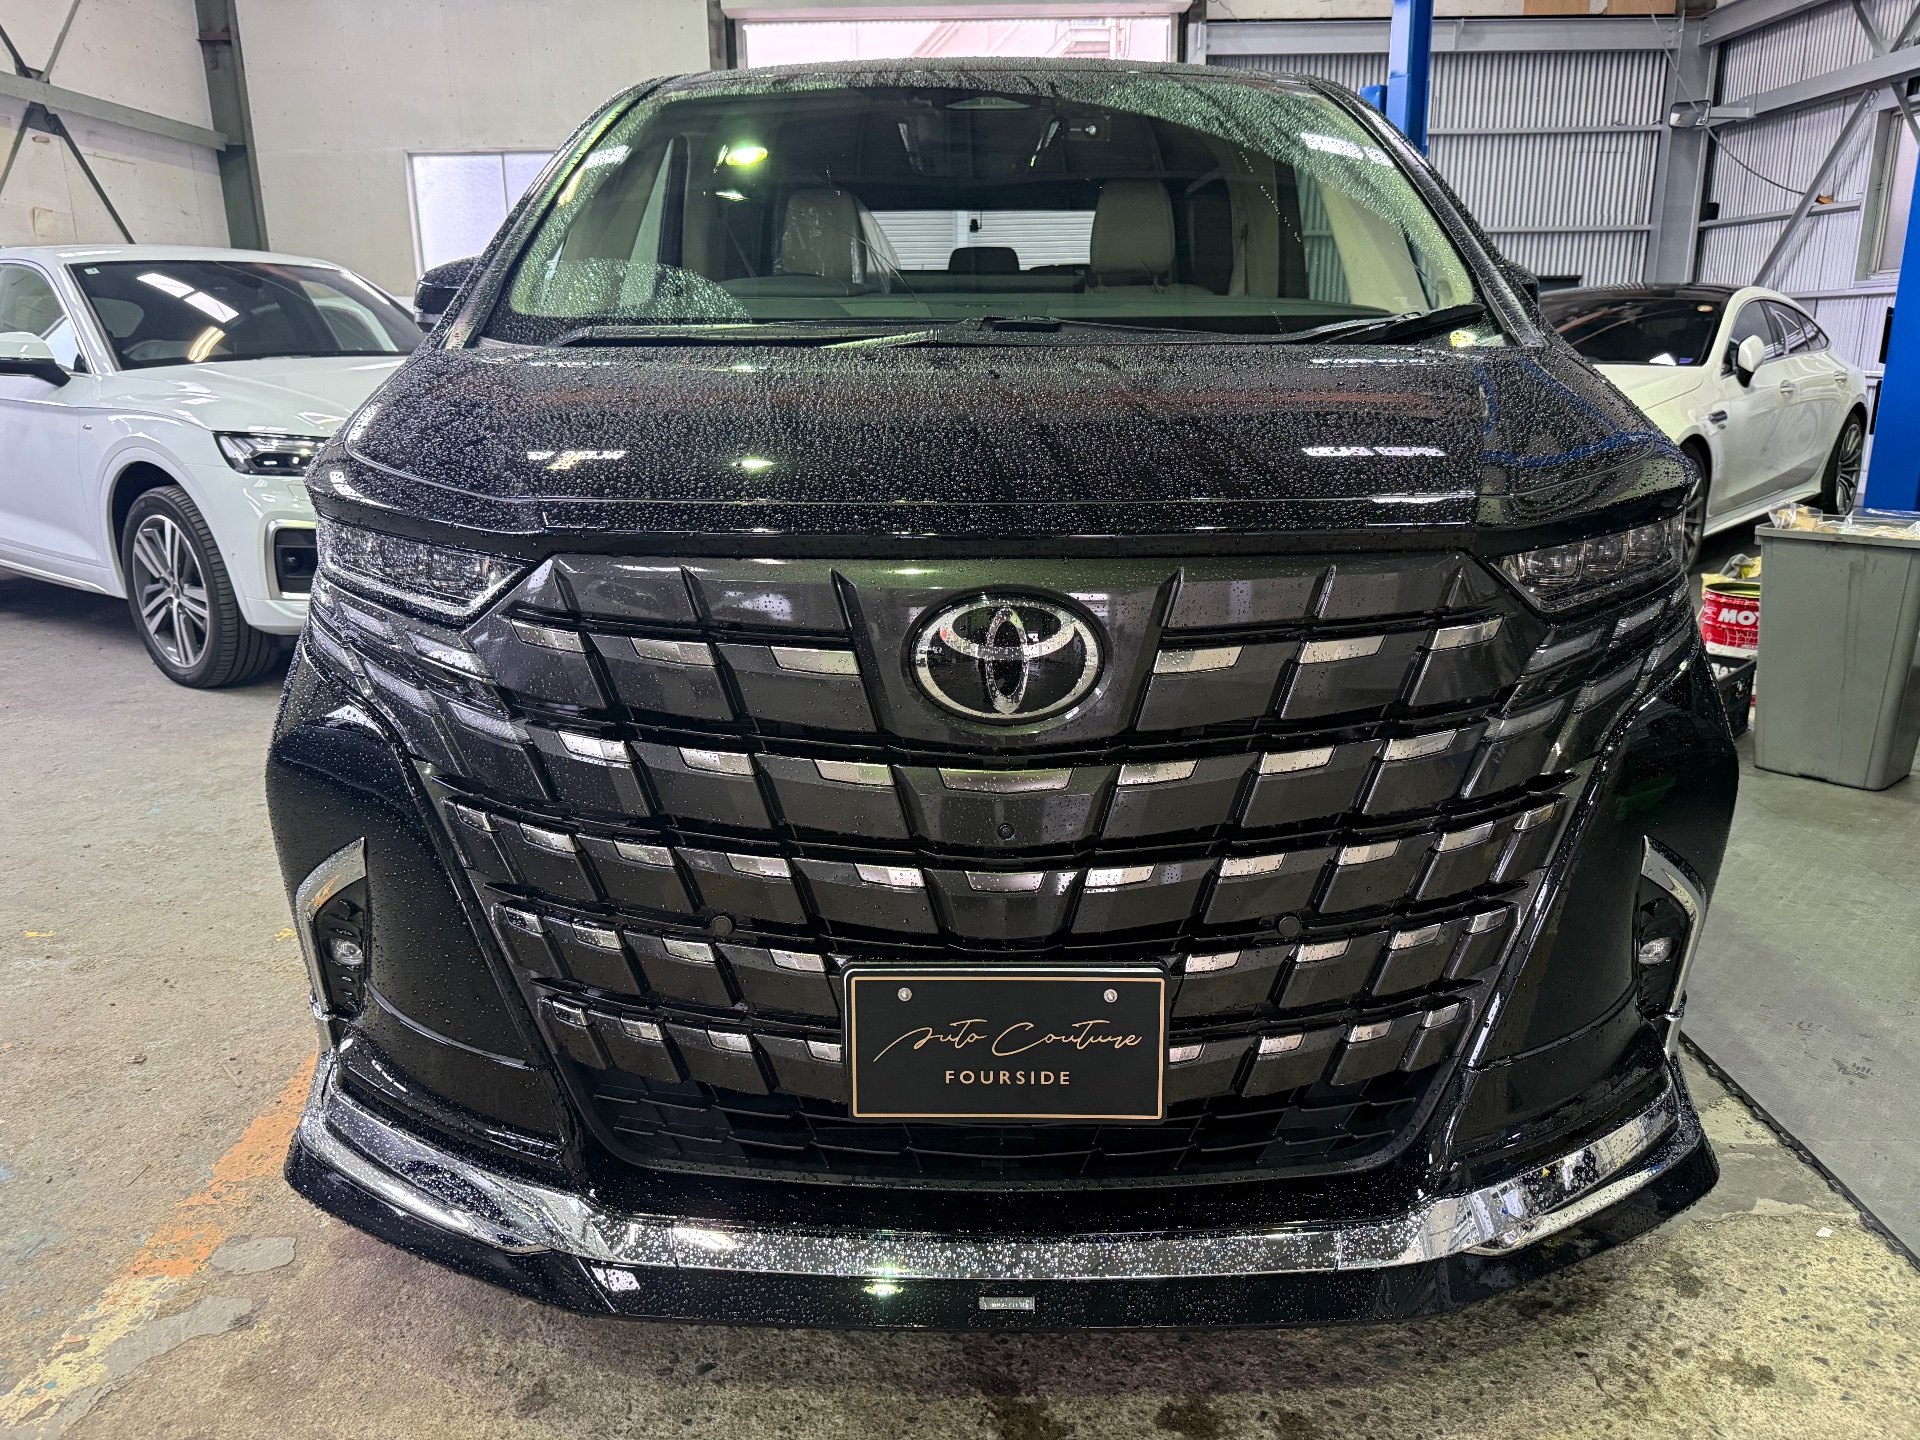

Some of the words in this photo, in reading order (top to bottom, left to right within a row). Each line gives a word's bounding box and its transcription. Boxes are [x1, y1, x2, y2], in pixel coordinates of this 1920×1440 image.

[874, 1019, 987, 1062] Auto
[991, 1020, 1143, 1057] Couture
[945, 1070, 1070, 1085] FOURSIDE
